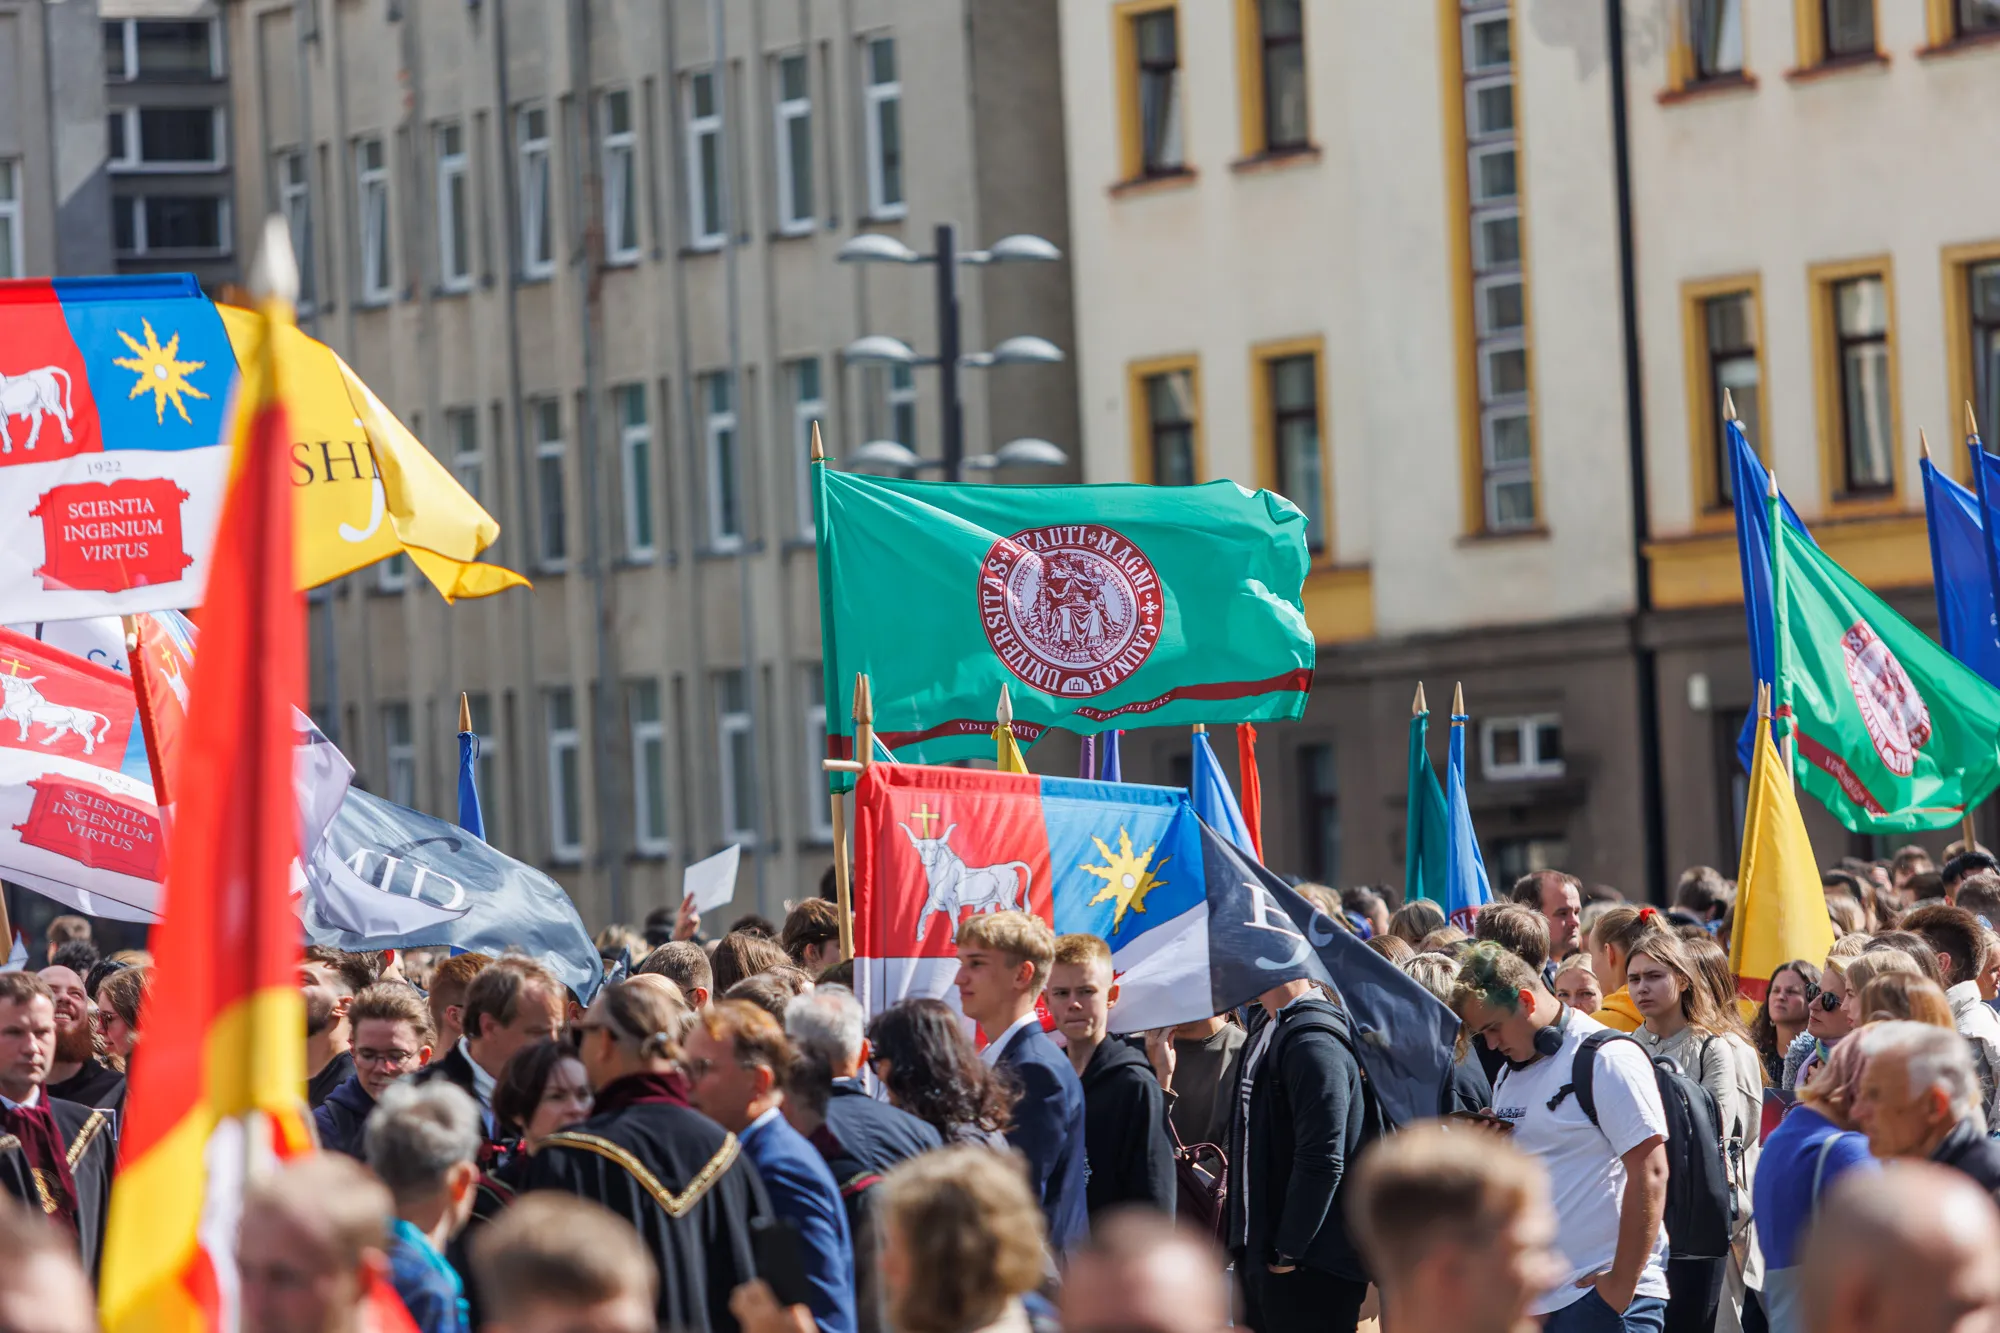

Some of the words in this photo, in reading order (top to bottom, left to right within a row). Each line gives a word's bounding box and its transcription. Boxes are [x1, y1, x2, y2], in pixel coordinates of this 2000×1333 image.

[87, 460, 123, 475] 1922
[67, 497, 156, 519] SCIENTIA
[63, 518, 164, 542] INGENIUM
[80, 541, 150, 562] VIRTUS
[982, 557, 1062, 691] UNIVERSITAS
[1094, 530, 1156, 594] MAGNI
[959, 722, 988, 731] VDU
[63, 789, 149, 827] SCIENTIA
[52, 801, 155, 843] INGENIUM
[66, 820, 136, 852] VIRTUS
